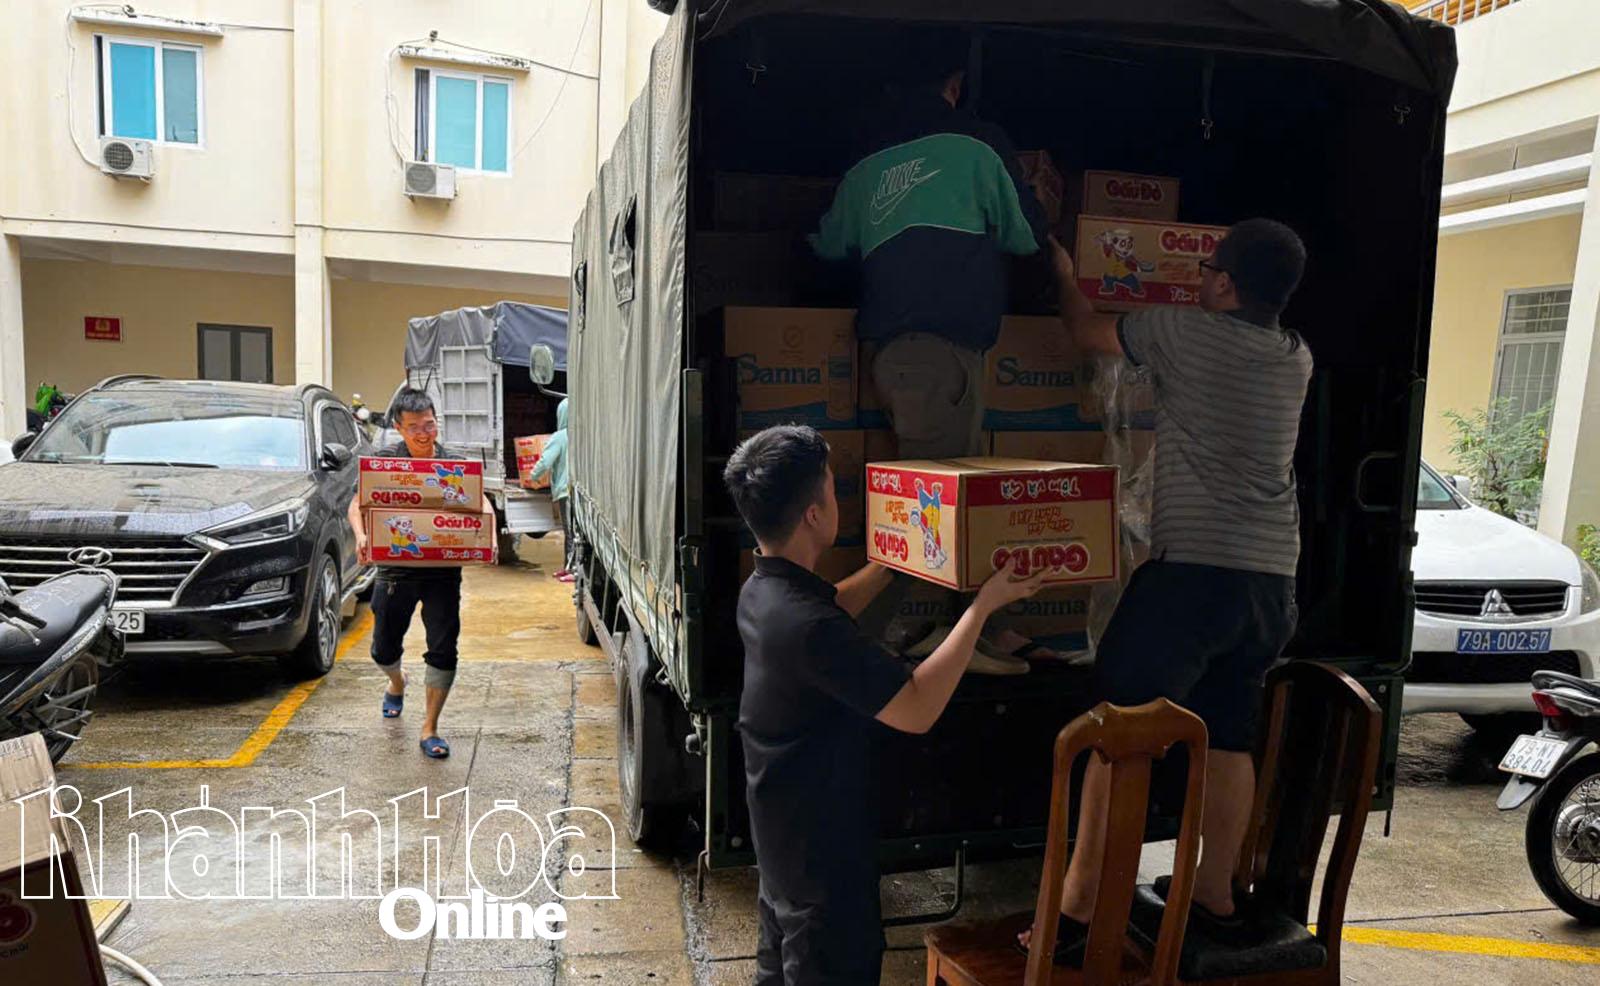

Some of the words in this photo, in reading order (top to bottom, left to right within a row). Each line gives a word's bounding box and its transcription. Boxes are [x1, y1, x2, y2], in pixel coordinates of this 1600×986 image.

[877, 158, 926, 200] NIKE
[737, 353, 821, 385] Sanna
[996, 357, 1074, 386] Sanna
[1000, 479, 1024, 500] Gà
[1048, 476, 1081, 498] Tôm
[1459, 630, 1549, 651] 79A-002.57
